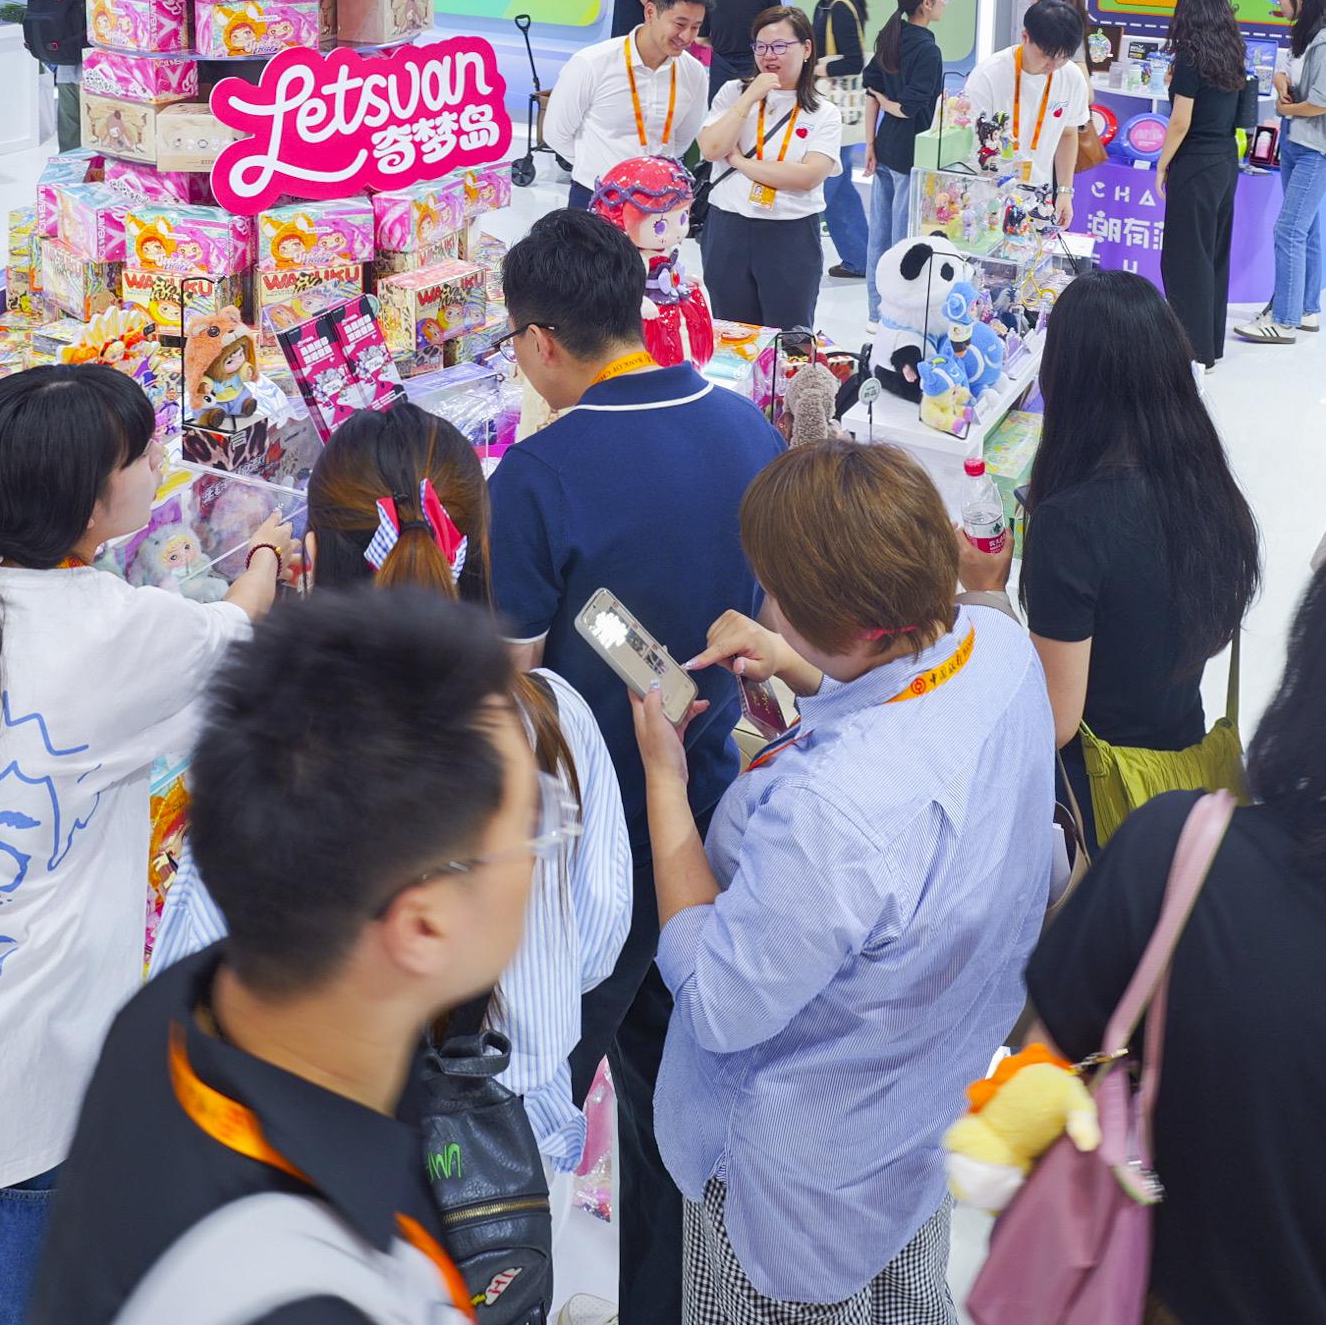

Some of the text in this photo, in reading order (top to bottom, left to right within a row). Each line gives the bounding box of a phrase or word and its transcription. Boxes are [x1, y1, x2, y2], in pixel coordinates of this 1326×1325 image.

[372, 104, 500, 175] 奇梦岛
[123, 273, 213, 296] WAKU
[262, 265, 360, 291] WAKU
[417, 270, 485, 307] WAKU
